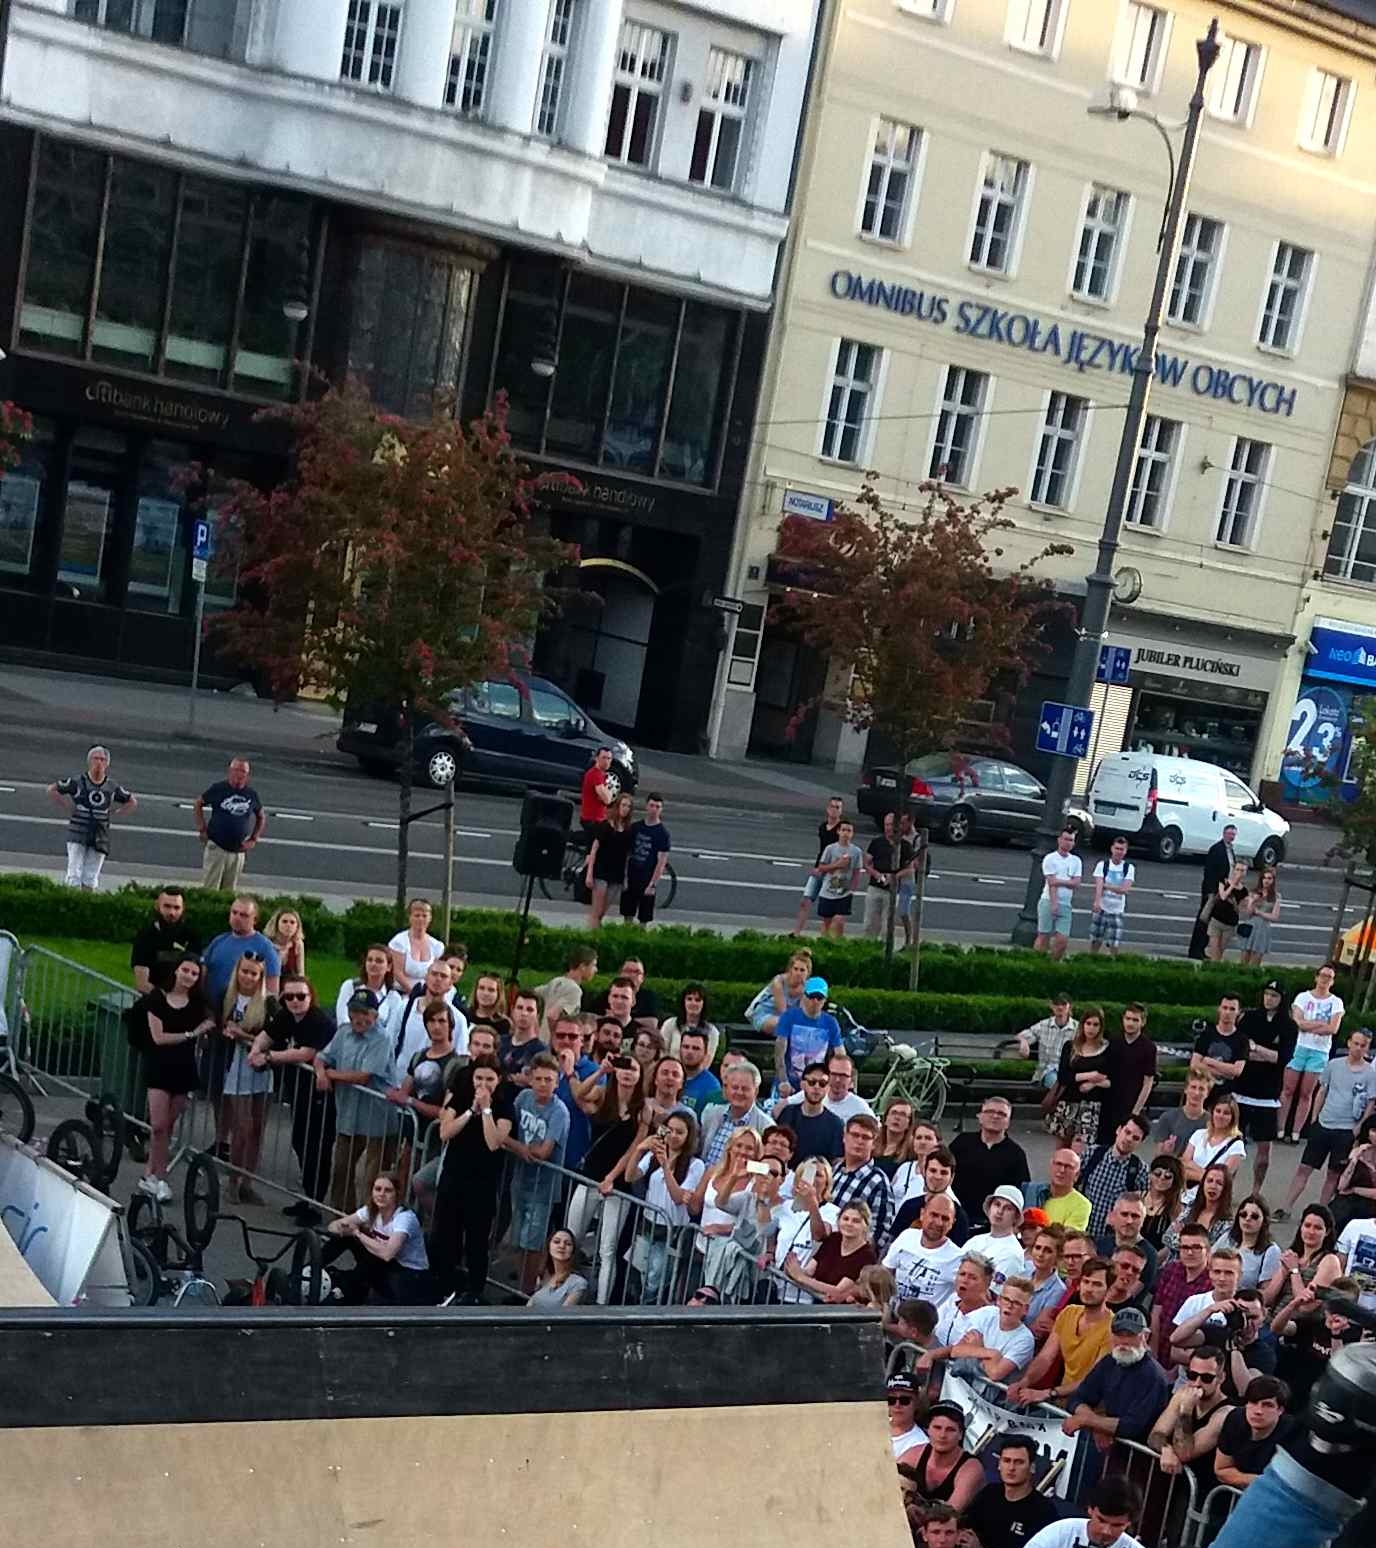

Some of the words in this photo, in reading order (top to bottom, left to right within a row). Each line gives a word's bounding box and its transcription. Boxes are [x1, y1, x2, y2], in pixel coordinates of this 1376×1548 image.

[830, 269, 949, 324] OMNIBUS
[956, 301, 1061, 358] SZKOŁA
[1064, 329, 1188, 387] JĘZYKW
[1191, 363, 1297, 417] OBCYCH
[196, 524, 208, 546] P
[1134, 647, 1182, 668] JUBILER
[1183, 656, 1240, 677] PLUCIŃSKI
